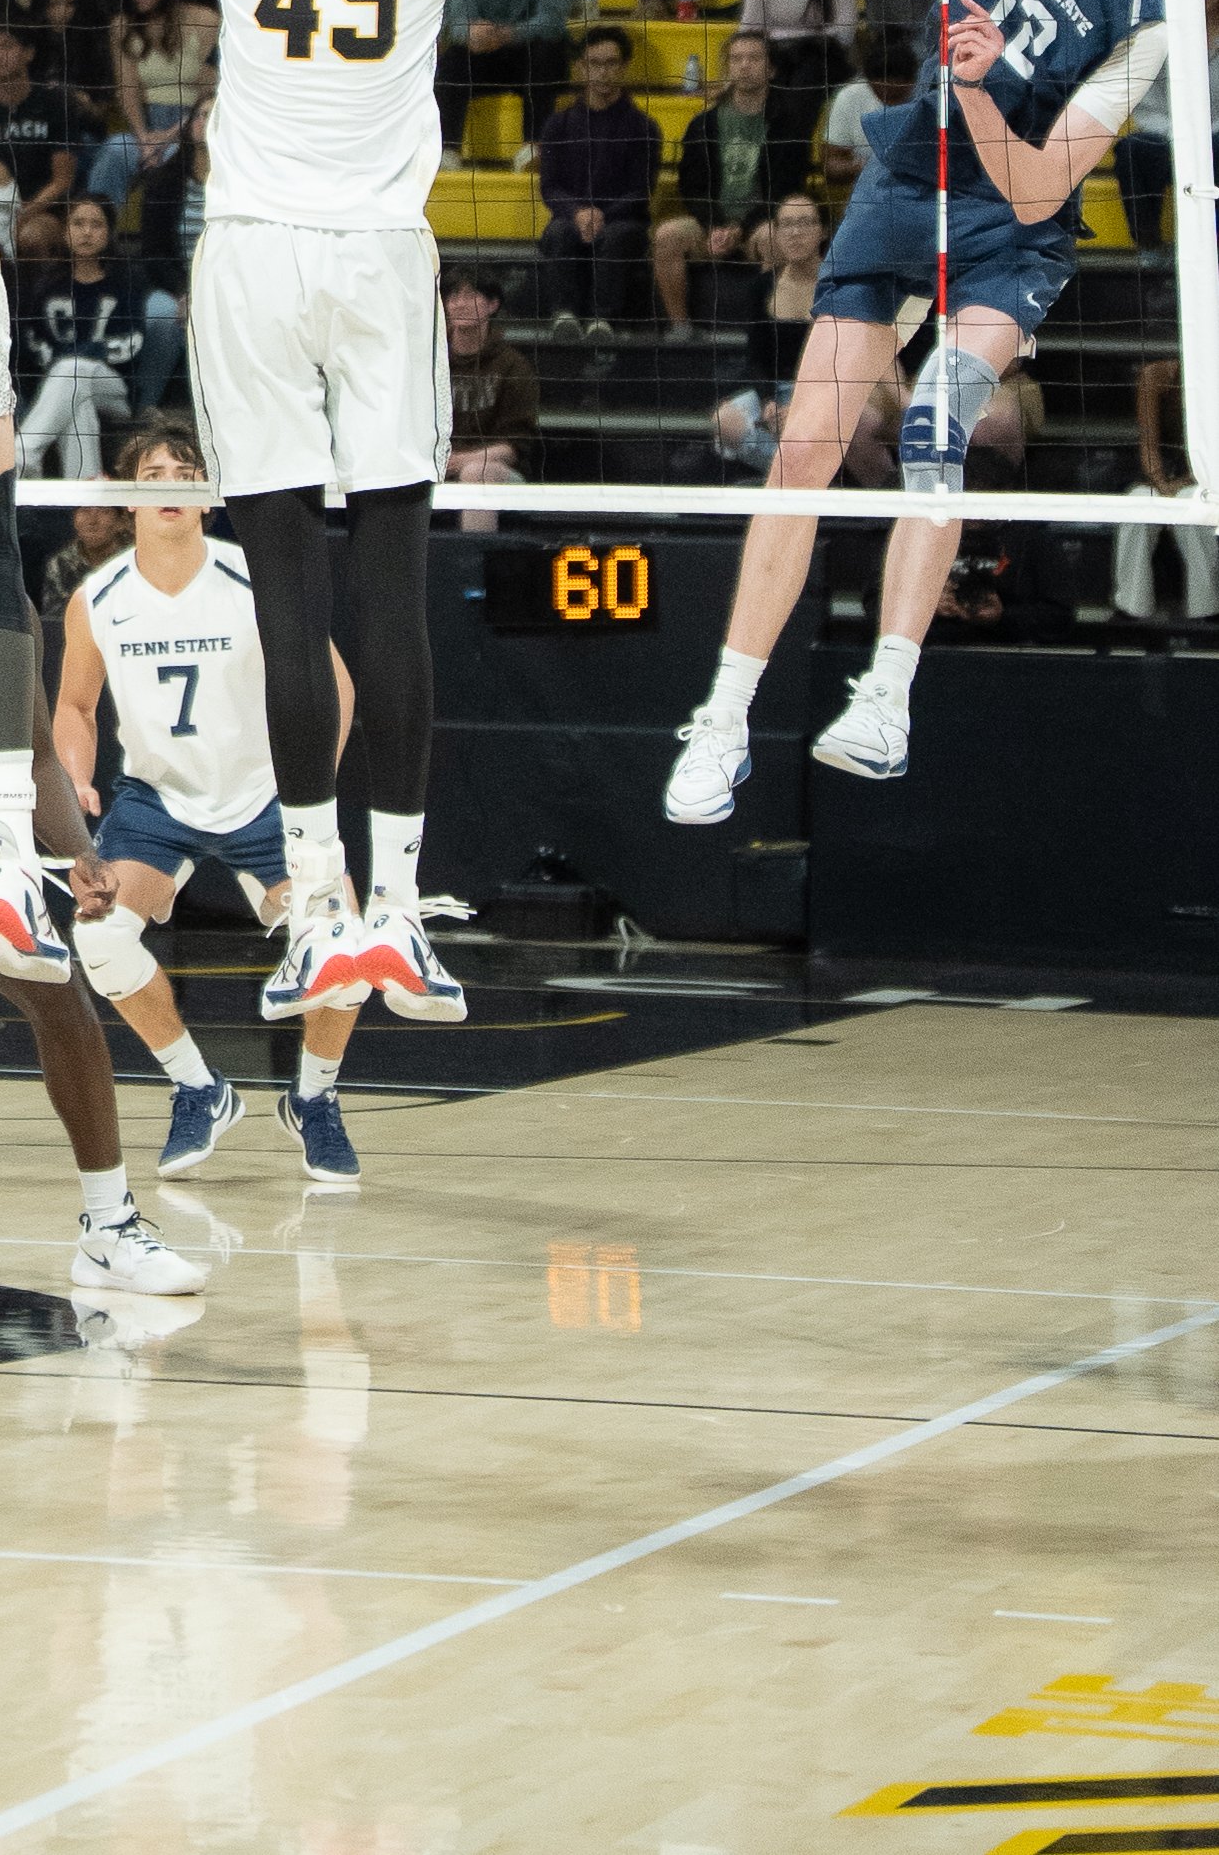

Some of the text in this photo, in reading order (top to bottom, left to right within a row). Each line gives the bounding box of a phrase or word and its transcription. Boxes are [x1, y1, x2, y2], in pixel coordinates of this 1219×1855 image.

[552, 545, 648, 620] 60
[119, 636, 233, 658] PENN STATE
[156, 664, 201, 739] 7
